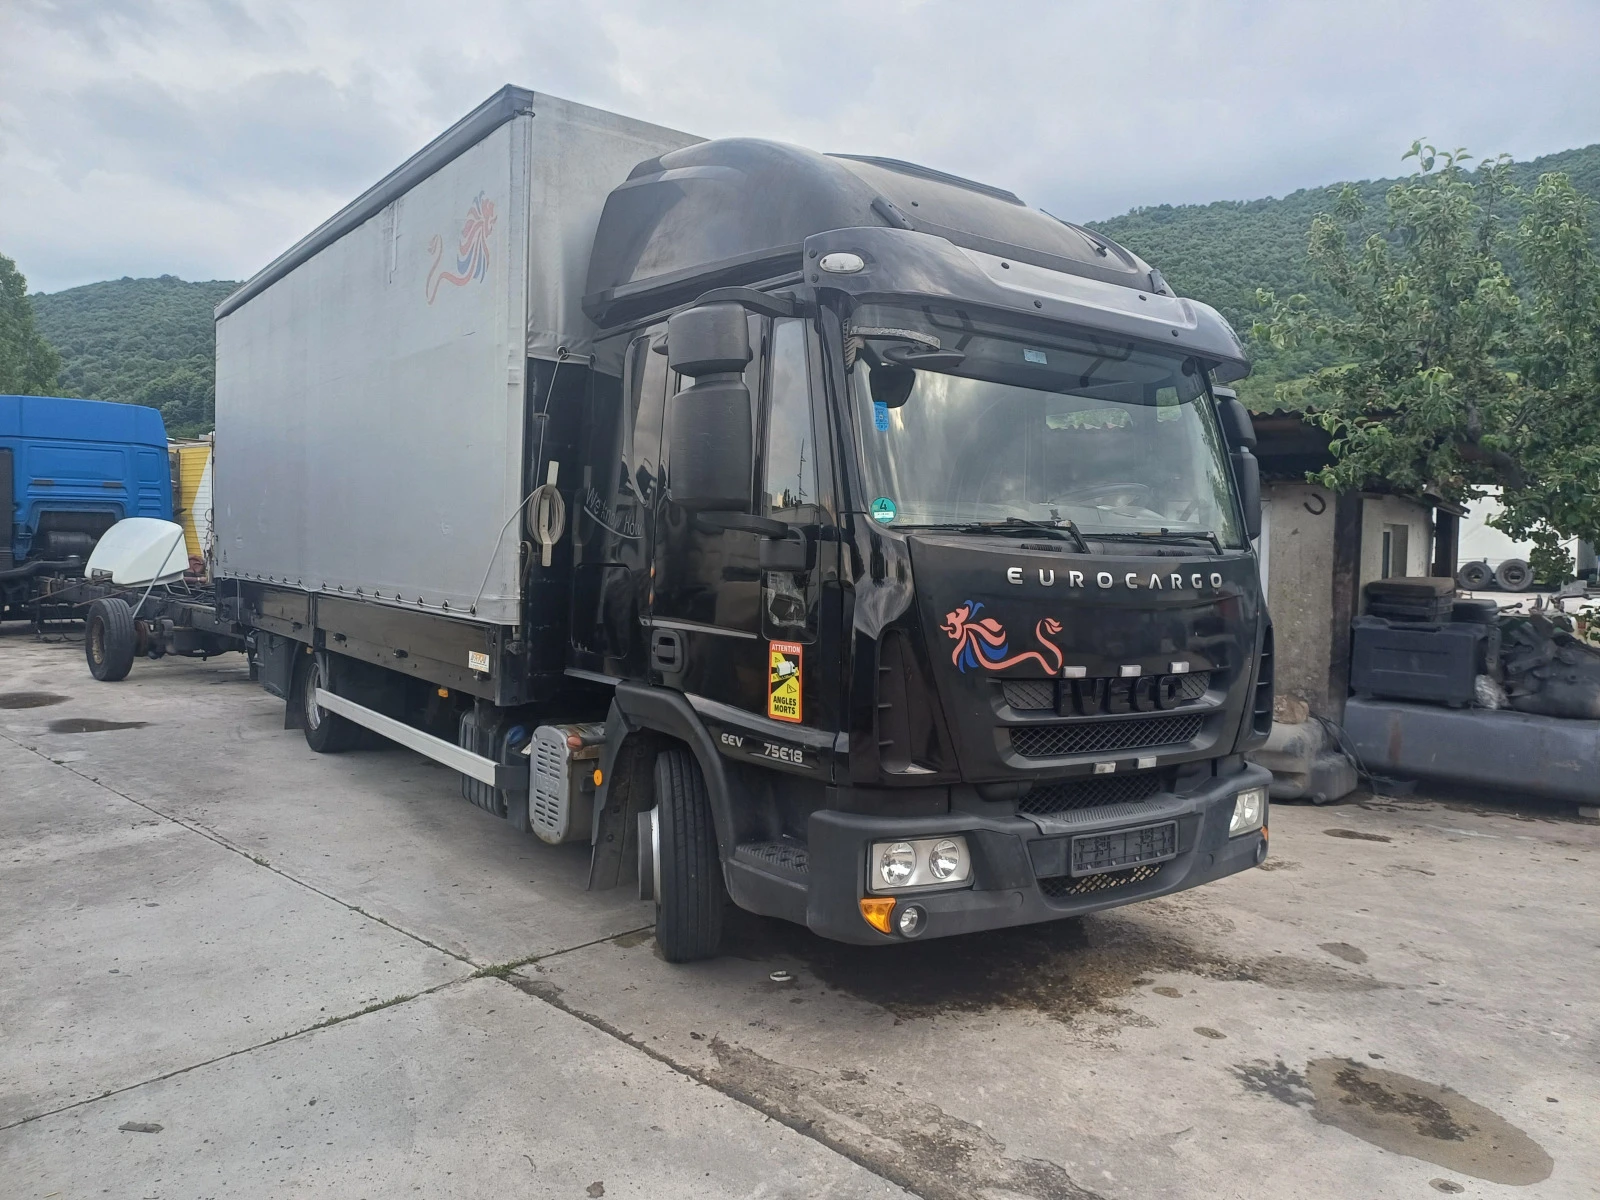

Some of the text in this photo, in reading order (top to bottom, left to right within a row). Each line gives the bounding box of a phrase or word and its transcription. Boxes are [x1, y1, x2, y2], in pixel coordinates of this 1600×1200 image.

[879, 499, 888, 511] 4
[1006, 566, 1223, 590] EUROCARGO
[771, 643, 801, 654] ATTENTION
[773, 695, 797, 707] ANGLES
[1057, 675, 1183, 717] IVECO
[773, 704, 796, 715] MORTS
[721, 733, 803, 764] EEV 75E18
